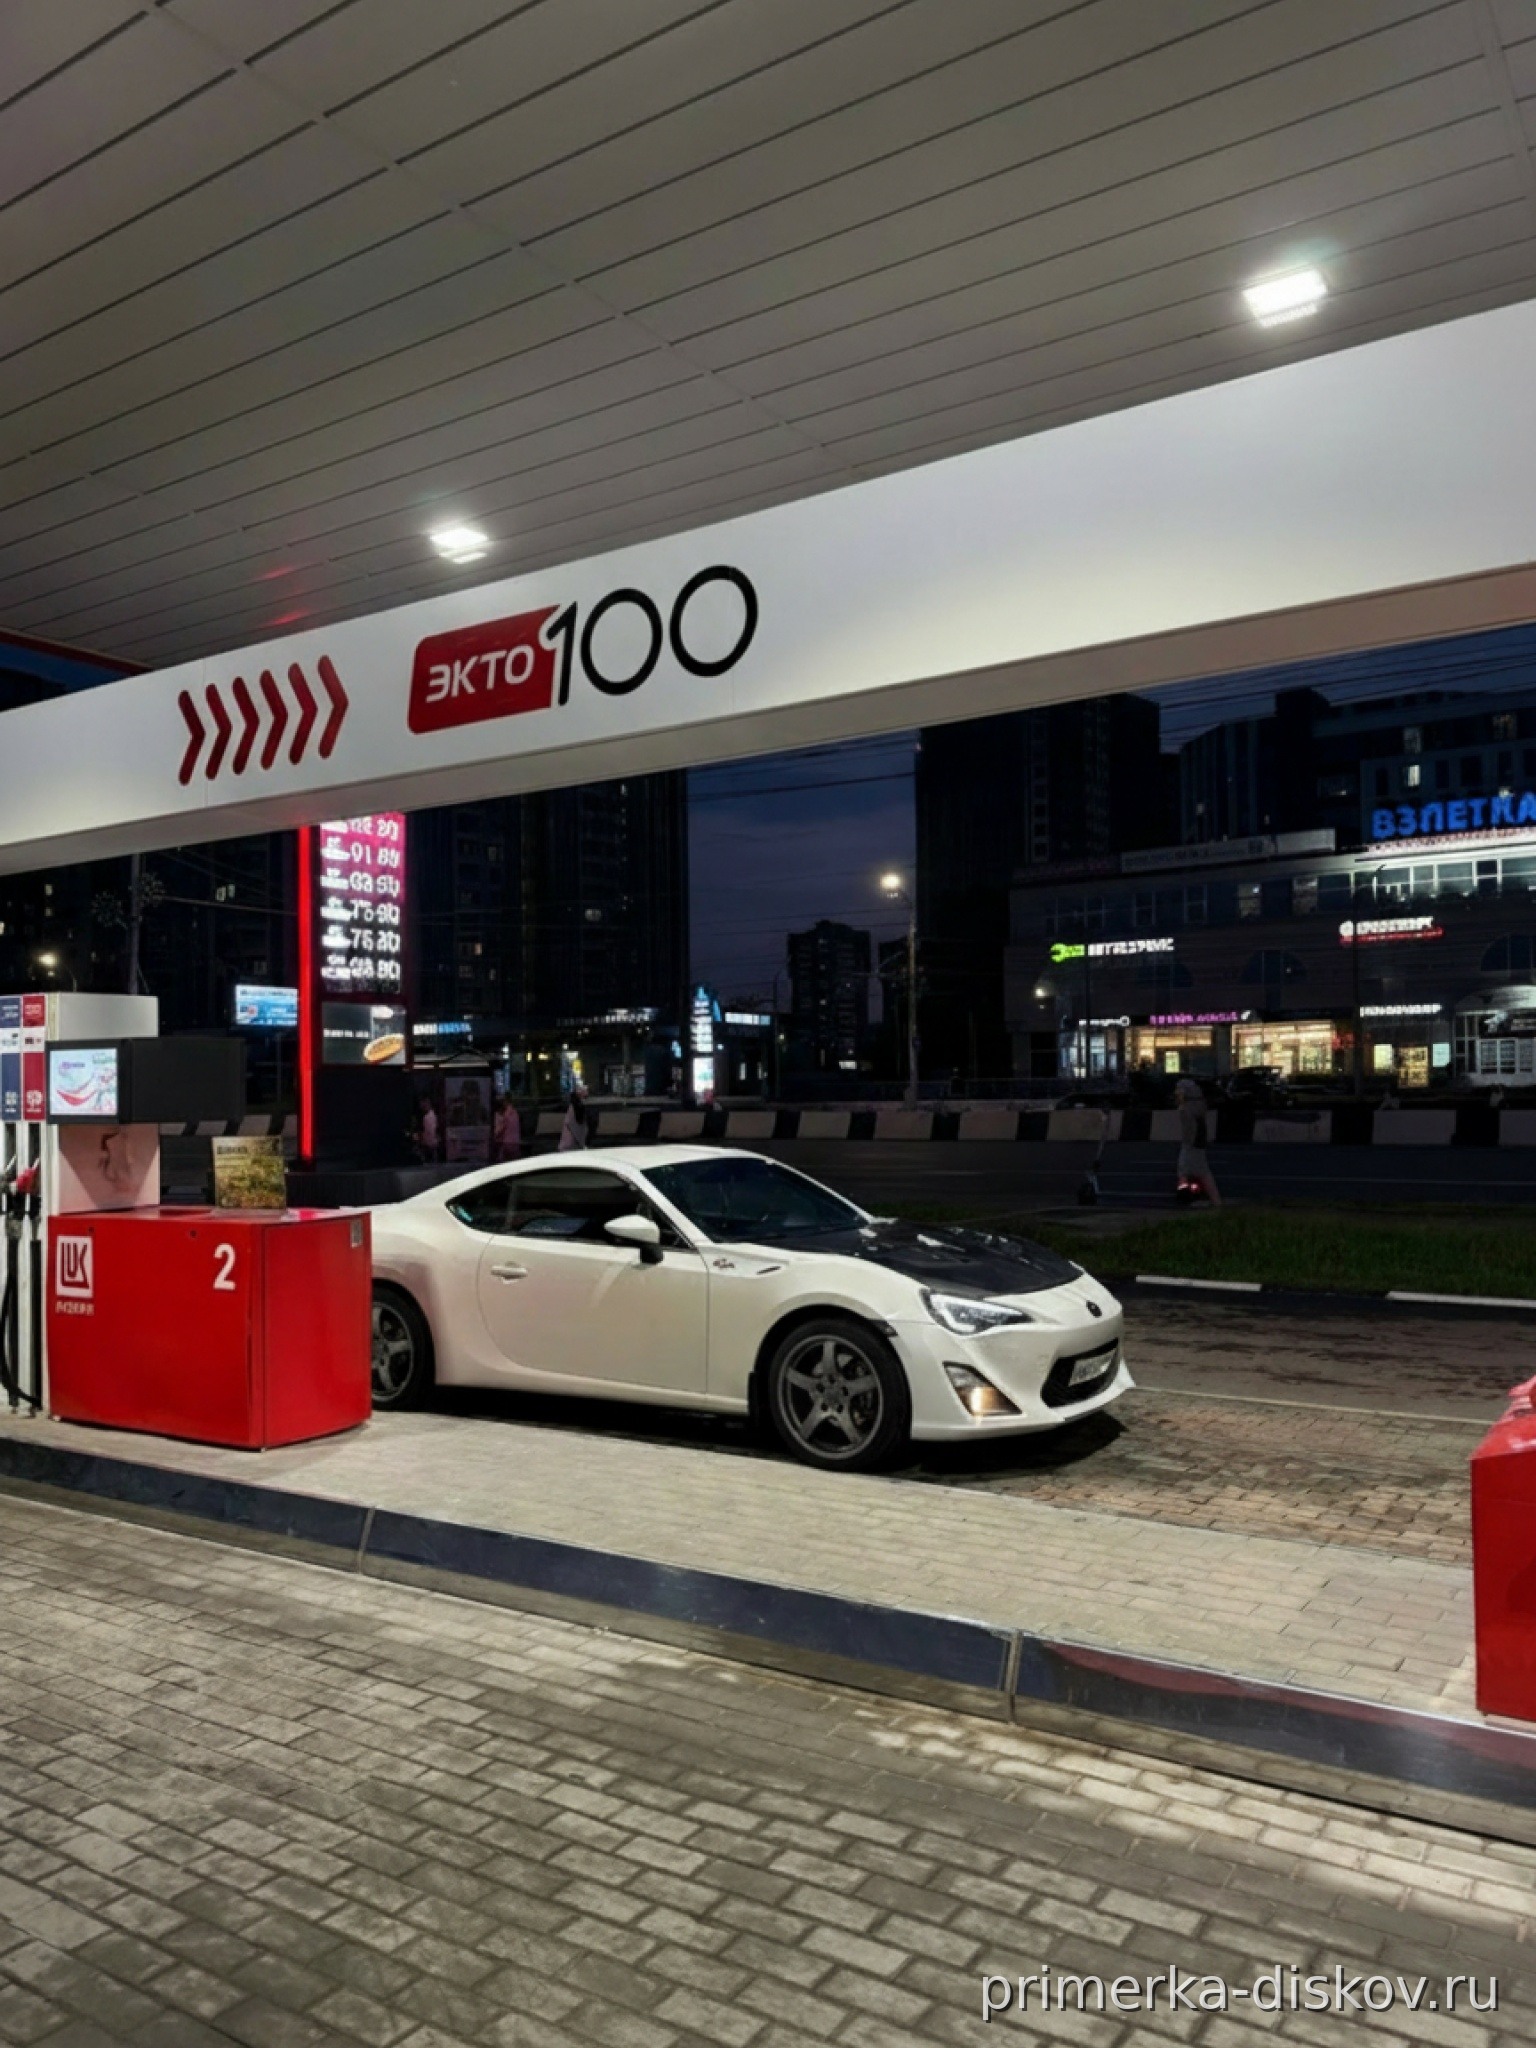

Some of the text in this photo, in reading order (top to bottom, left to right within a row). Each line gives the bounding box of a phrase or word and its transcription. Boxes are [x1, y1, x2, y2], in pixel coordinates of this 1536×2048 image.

[426, 564, 759, 707] ЭКТО 100
[212, 1242, 237, 1291] 2
